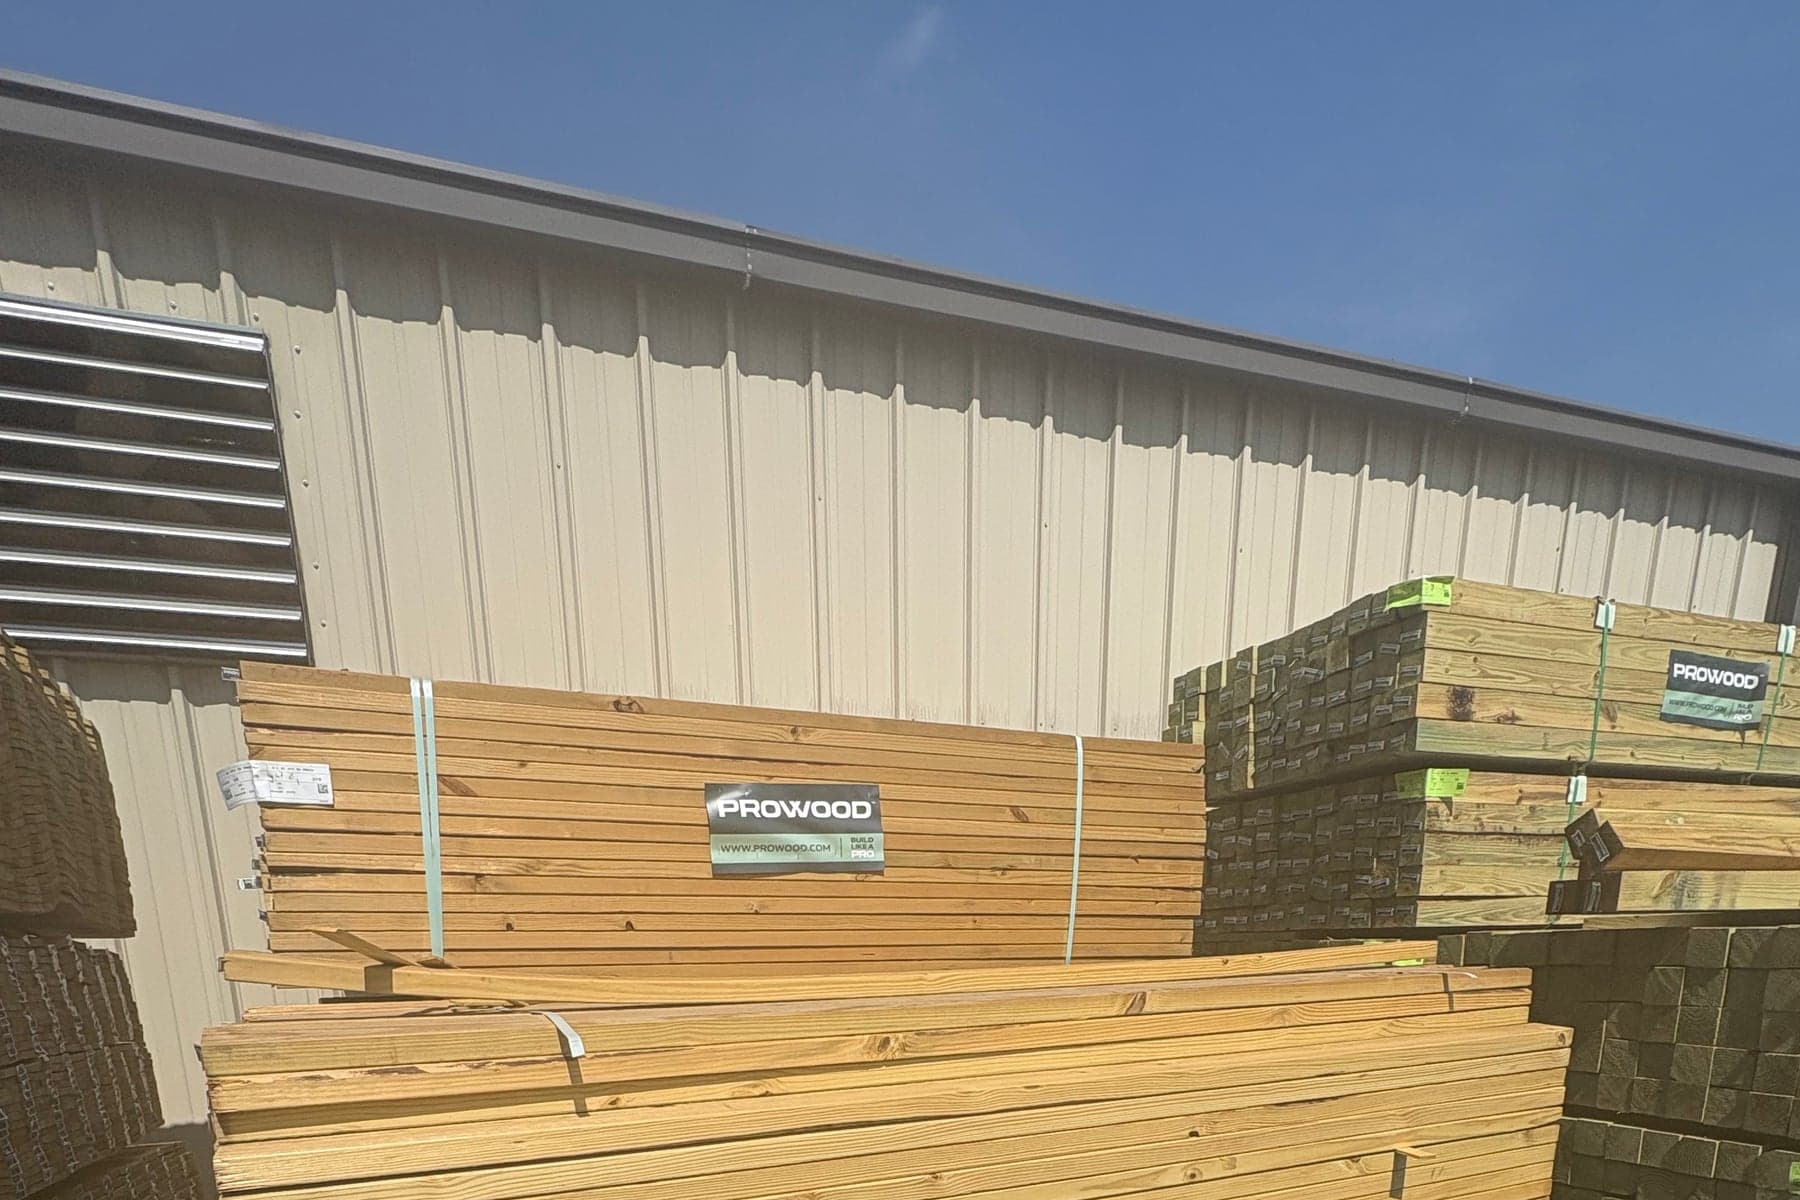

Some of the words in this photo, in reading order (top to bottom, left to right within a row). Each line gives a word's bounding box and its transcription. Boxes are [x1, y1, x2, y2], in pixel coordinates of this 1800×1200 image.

[1673, 663, 1759, 690] PROWOOD
[716, 799, 872, 819] PROWOOD
[720, 844, 831, 853] WWW.PROWOOD.COM
[851, 850, 875, 858] PRO
